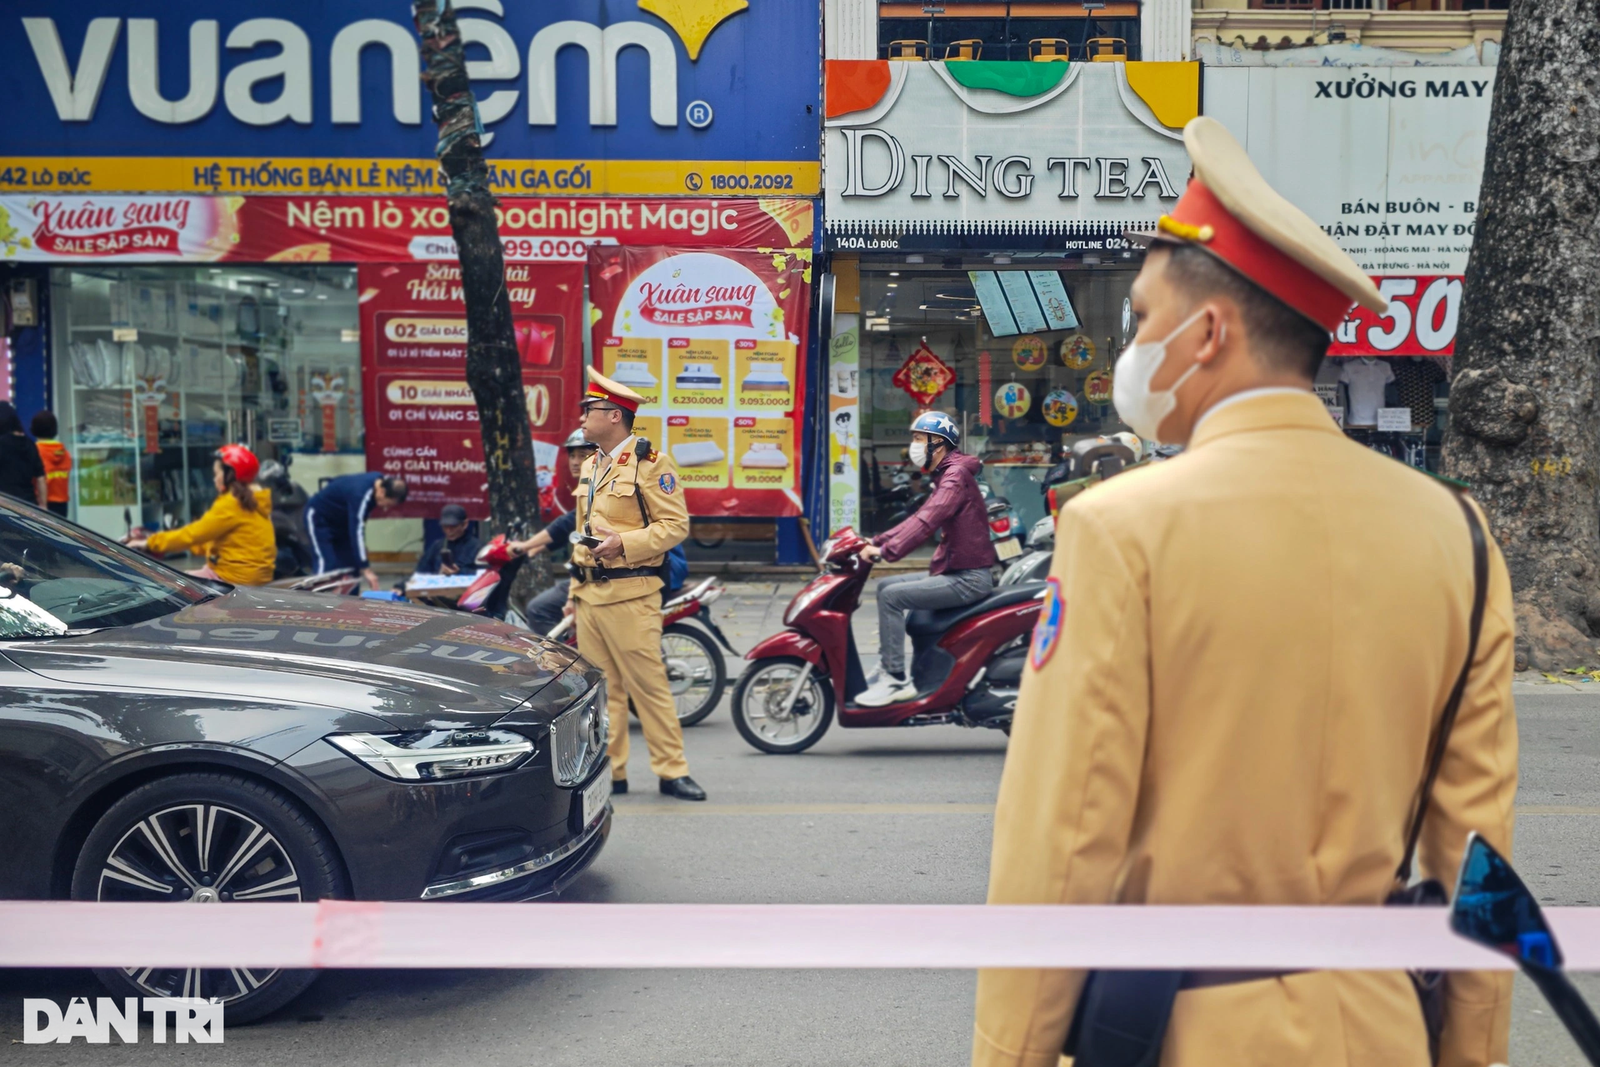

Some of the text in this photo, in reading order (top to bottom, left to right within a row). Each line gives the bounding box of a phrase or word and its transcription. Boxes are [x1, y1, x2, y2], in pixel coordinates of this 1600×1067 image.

[1314, 73, 1489, 98] XƯỞNG MAY
[840, 127, 1180, 199] DING TEA
[32, 168, 54, 186] LÒ
[57, 167, 92, 186] ĐÚC
[193, 162, 222, 191] HỆ
[227, 161, 303, 187] THỐNG
[308, 163, 352, 187] BÁN
[356, 162, 381, 187] LẺ
[386, 164, 433, 191] NỆM
[487, 165, 516, 188] ĂN
[520, 169, 550, 188] GA
[553, 163, 591, 188] GỐI
[710, 174, 793, 190] 1800.2092
[1341, 198, 1380, 214] BÁN
[1385, 198, 1440, 214] BUÔN
[32, 199, 191, 238] Xuân sang
[287, 200, 739, 236] Nệm lò xo odnight Magic
[1320, 221, 1360, 240] HẬN
[1364, 222, 1401, 240] ĐẶT
[1406, 224, 1449, 236] MAY
[53, 230, 170, 253] SALE SẬP SÀN
[836, 237, 899, 249] 140A LÒ ĐÚC
[1065, 240, 1103, 249] HOTLINE
[1105, 238, 1129, 249] 024
[1437, 245, 1451, 253] HÀ
[1417, 261, 1431, 269] HÀ
[1432, 261, 1450, 271] NỘI
[406, 279, 449, 300] Hái
[507, 287, 537, 308] ay
[638, 282, 757, 309] Xuân sang
[653, 308, 744, 325] SALE SẬP SÀN
[395, 323, 418, 338] 02
[398, 385, 418, 400] 10
[672, 396, 724, 405] 6.230.000đ
[739, 397, 791, 406] 9.093.000đ
[428, 408, 464, 420] VÀNG
[680, 474, 719, 483] 49.000đ
